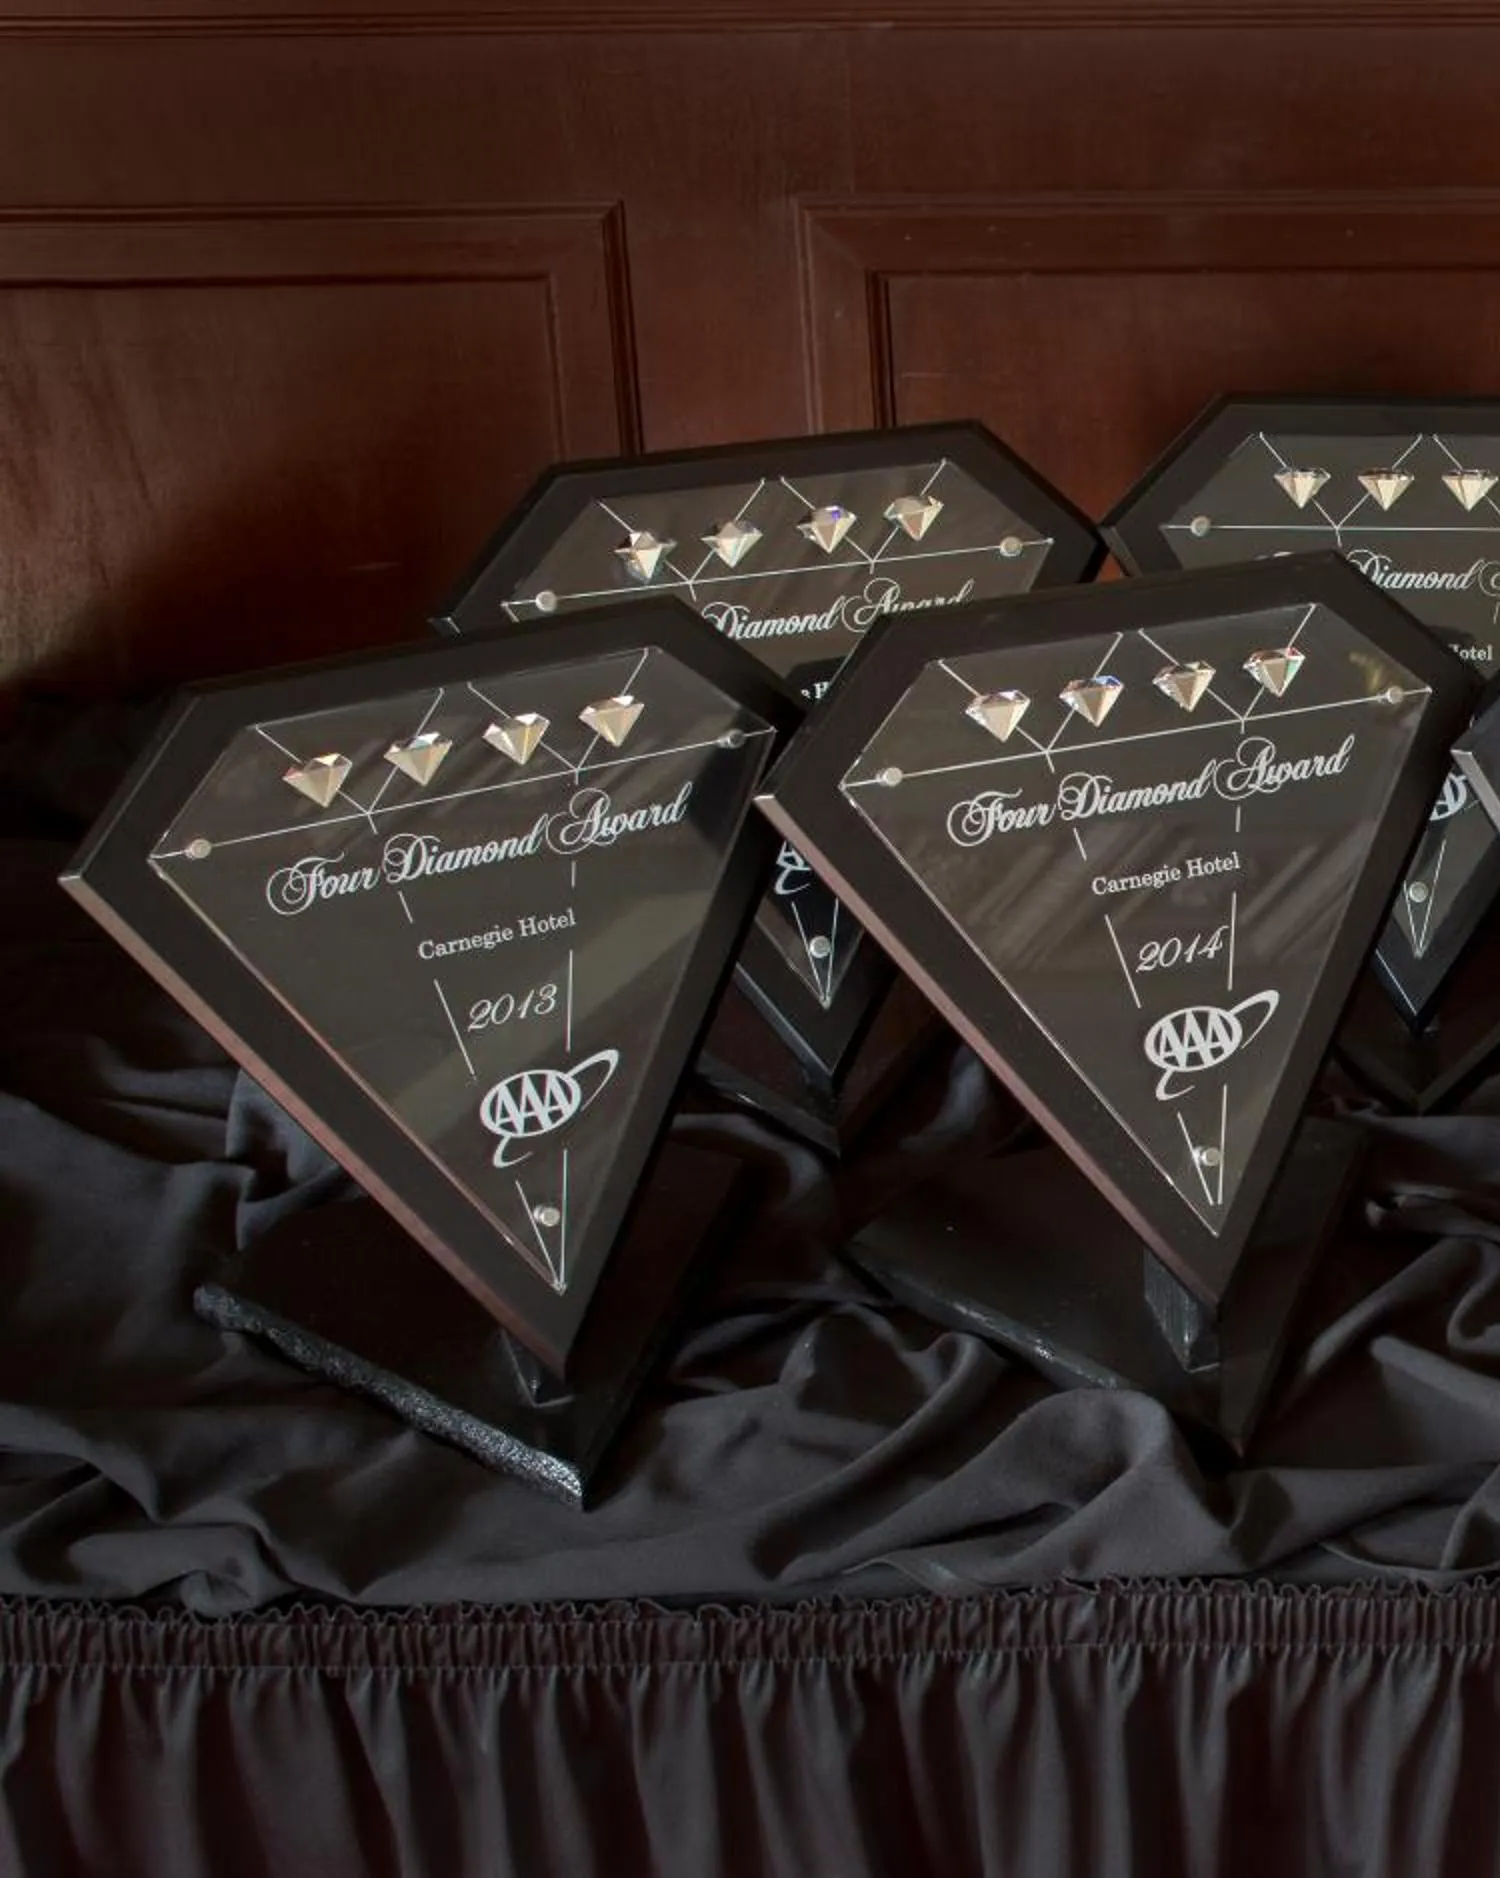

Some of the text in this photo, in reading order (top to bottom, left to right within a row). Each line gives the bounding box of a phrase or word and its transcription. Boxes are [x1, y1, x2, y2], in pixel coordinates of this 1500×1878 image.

[701, 596, 846, 640] Diamond
[946, 788, 1055, 847] Four
[1057, 759, 1217, 822] Diamond
[1213, 733, 1355, 800] Award
[266, 851, 379, 915] Four
[383, 814, 548, 884] Diamond
[545, 781, 692, 855] Award
[1091, 852, 1241, 896] Carnegie Hotel
[418, 908, 577, 960] Carnegie Hotel
[1135, 925, 1230, 973] 2014
[467, 983, 558, 1033] 2013
[1151, 1007, 1239, 1071] AAA
[487, 1070, 578, 1137] AAA
